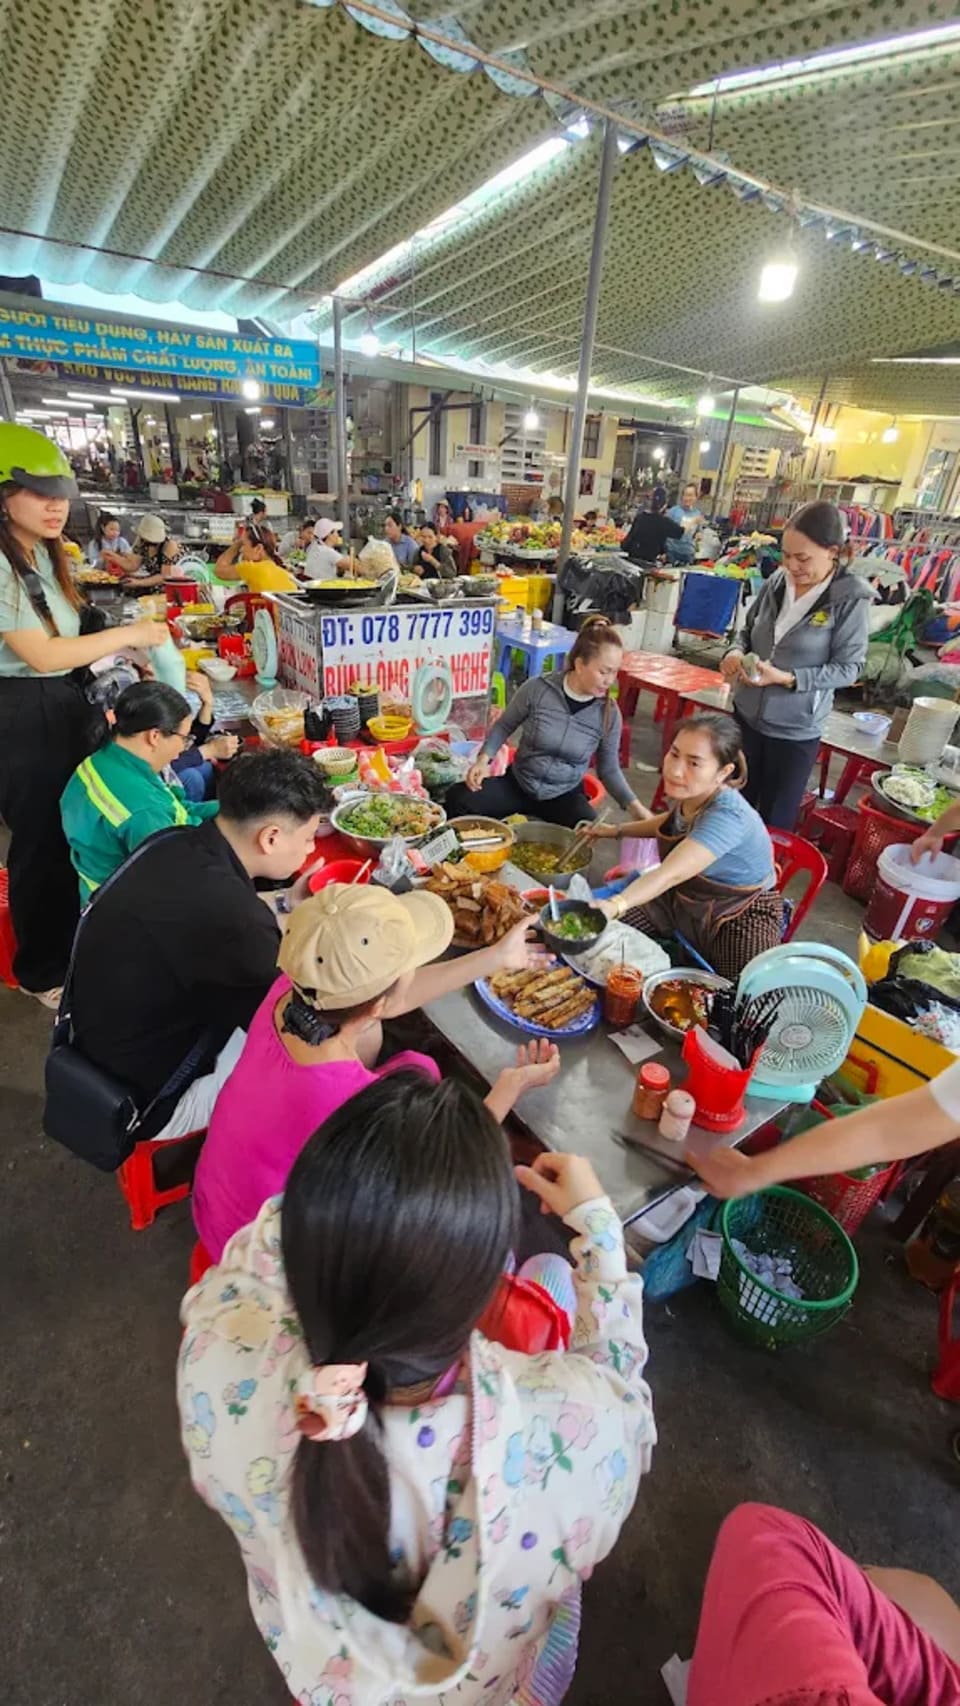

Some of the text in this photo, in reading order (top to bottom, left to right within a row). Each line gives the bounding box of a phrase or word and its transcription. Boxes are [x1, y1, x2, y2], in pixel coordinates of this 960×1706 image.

[132, 346, 177, 368] CHẤT
[273, 343, 294, 359] RA
[322, 616, 354, 648] ĐT:
[361, 614, 400, 645] 078
[406, 611, 454, 641] 7777
[458, 609, 493, 637] 399
